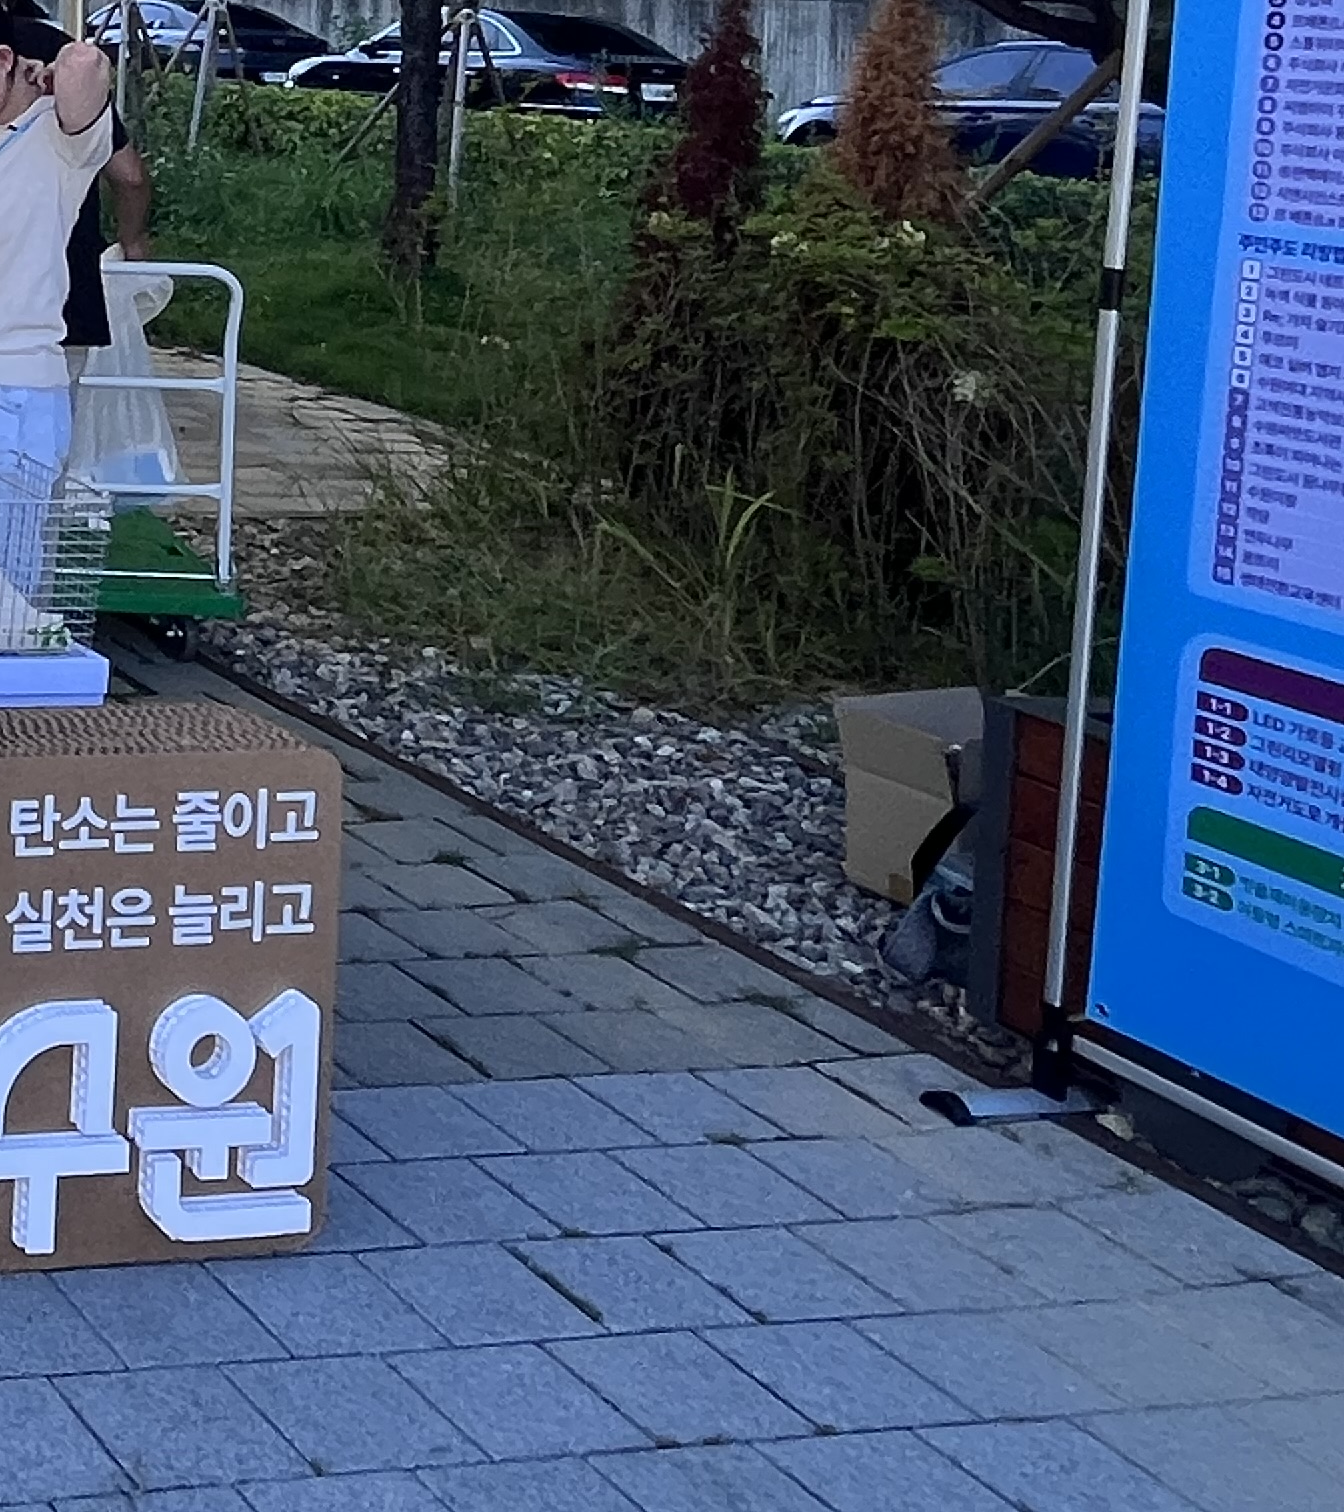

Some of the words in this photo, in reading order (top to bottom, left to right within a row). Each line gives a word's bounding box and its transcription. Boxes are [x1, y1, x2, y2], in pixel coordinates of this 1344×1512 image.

[1210, 698, 1232, 715] 1-1
[1207, 722, 1231, 740] 1-2
[10, 793, 161, 859] 탄소는
[172, 789, 320, 853] 줄이고
[5, 887, 155, 954] 실천은
[169, 881, 315, 945] 늘리고
